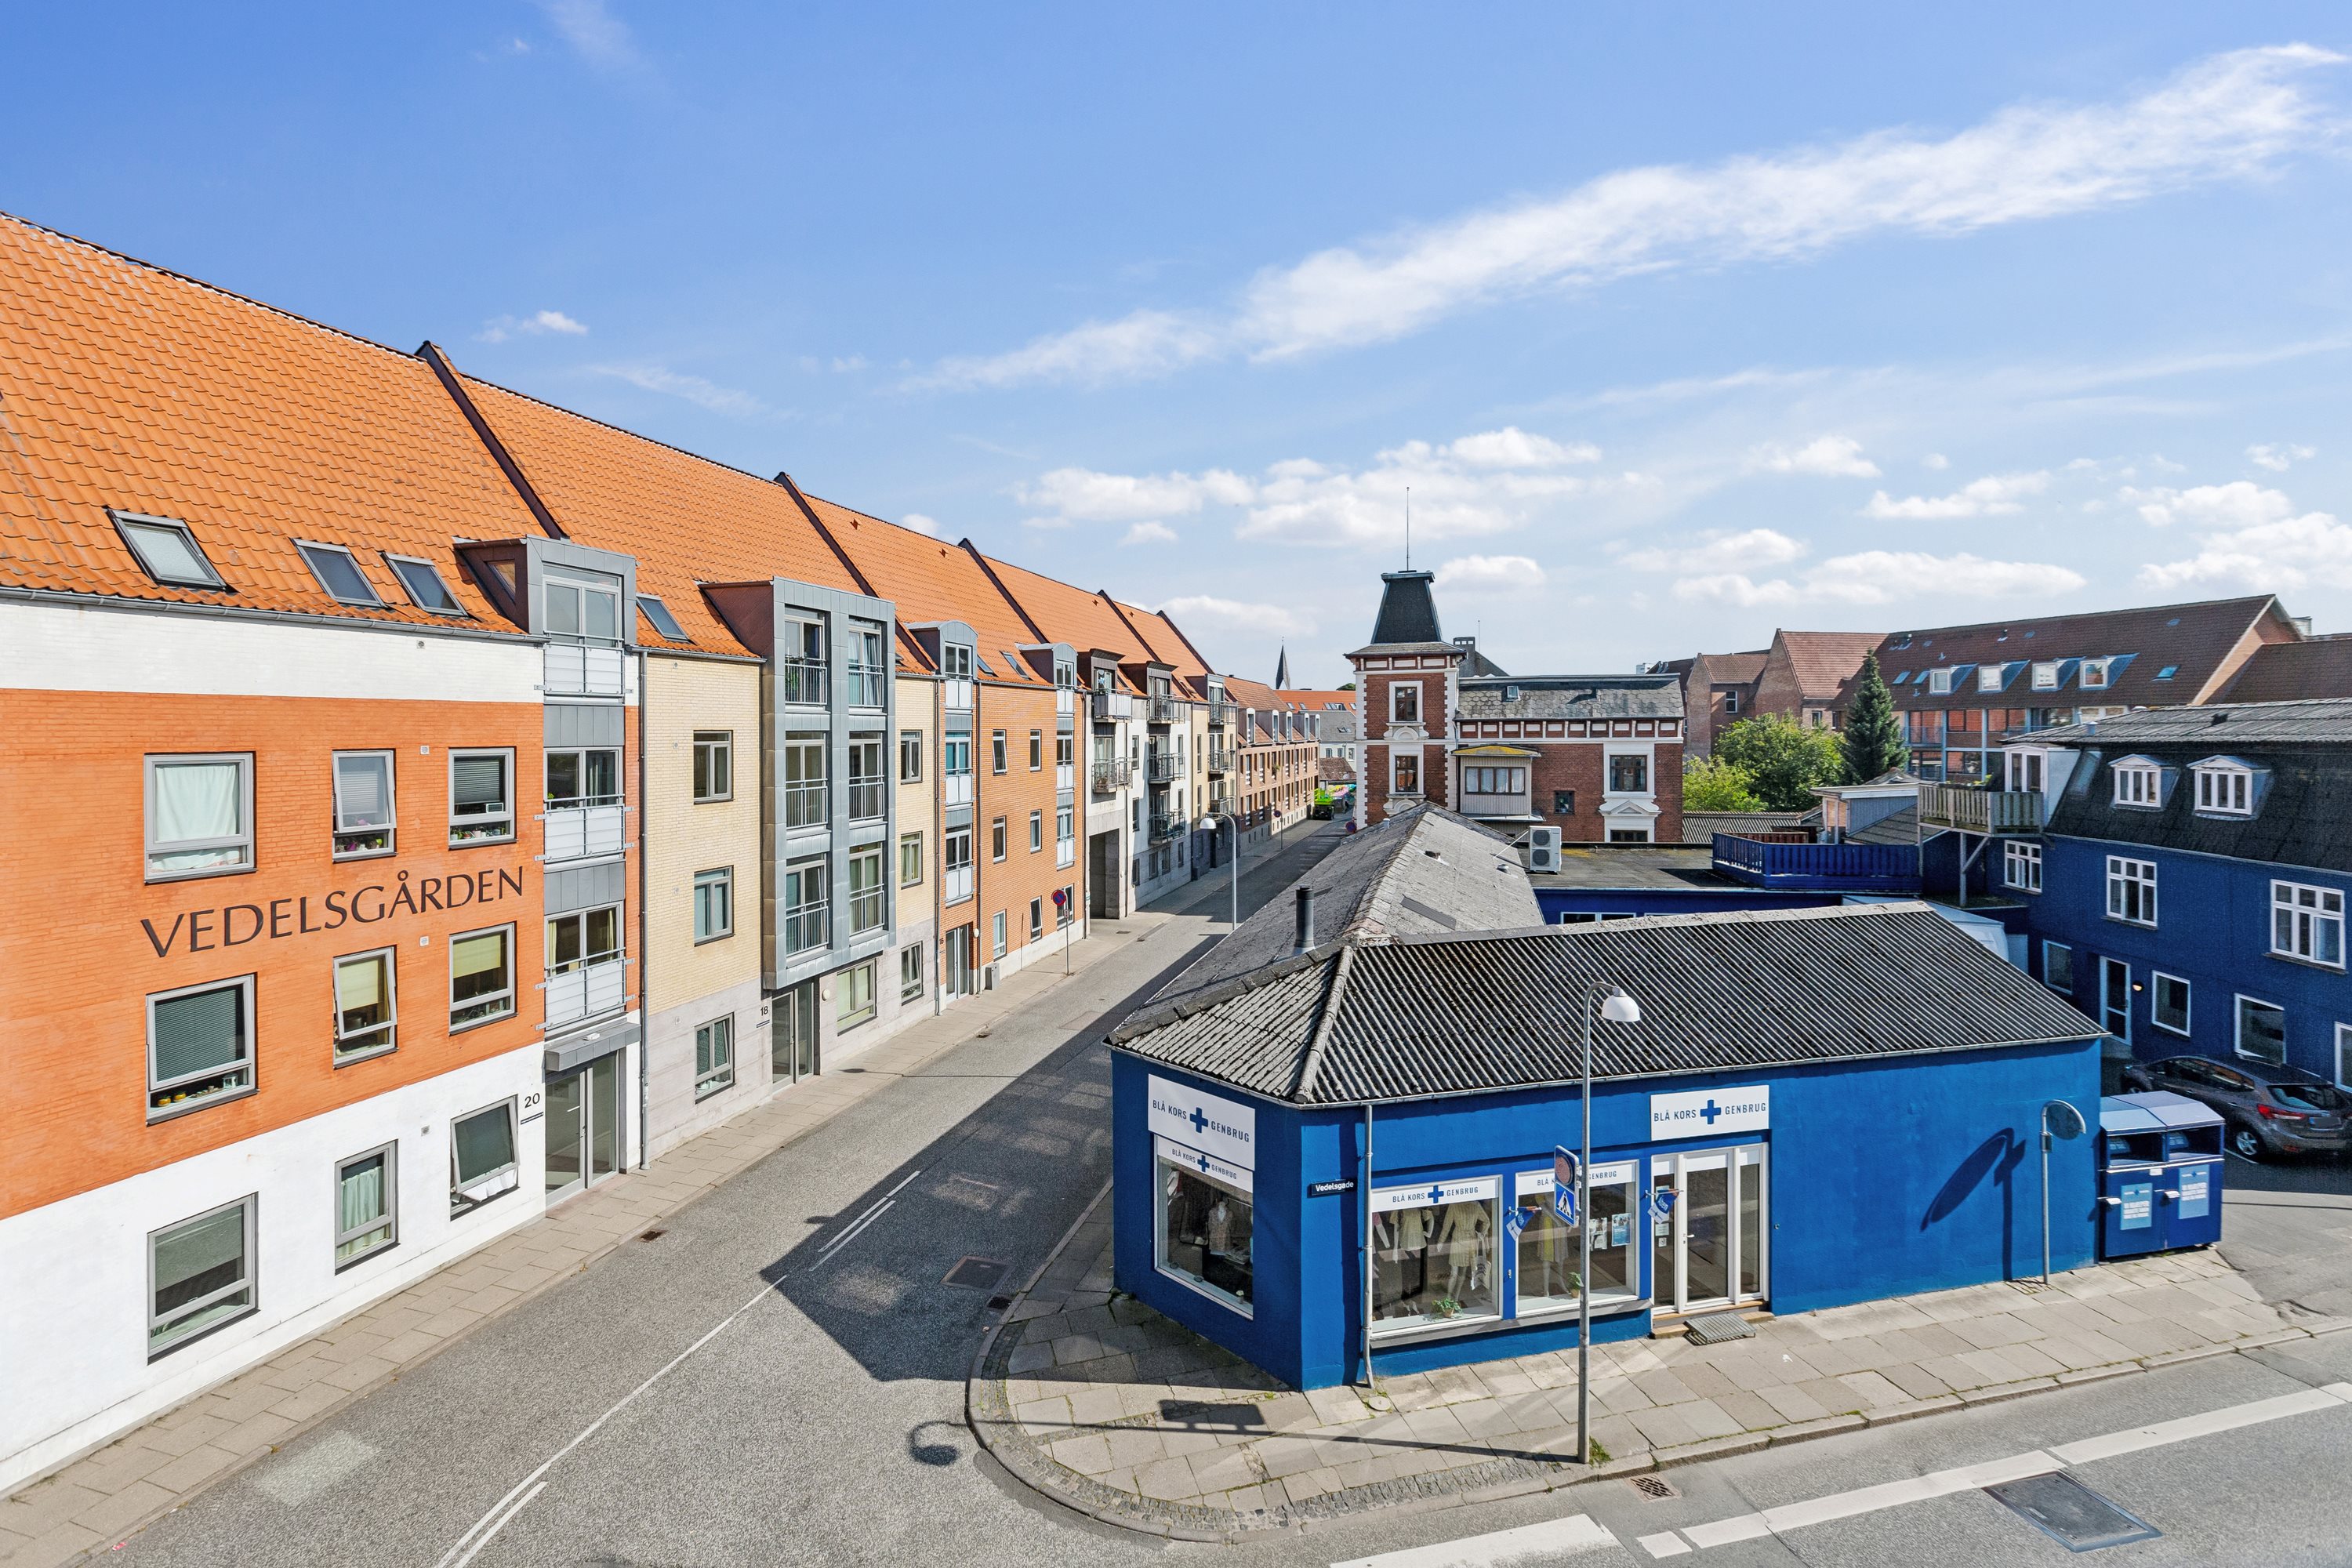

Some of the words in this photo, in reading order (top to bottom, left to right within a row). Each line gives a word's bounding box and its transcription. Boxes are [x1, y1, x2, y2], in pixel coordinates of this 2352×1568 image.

[140, 866, 523, 958] VEDELSGÅRDEN
[760, 1006, 768, 1016] 18
[524, 1092, 540, 1109] 20
[1653, 1110, 1671, 1122] BLÅ
[1674, 1109, 1697, 1120] KORS
[1725, 1102, 1766, 1115] GENBRUG
[1152, 1100, 1166, 1112] BLÅ
[1168, 1105, 1187, 1120] KORS
[1210, 1120, 1250, 1142] GENBRUG
[1172, 1149, 1181, 1157] BLÅ
[1182, 1152, 1196, 1163] KORS
[1211, 1164, 1237, 1179] GENBRUG
[1315, 1181, 1354, 1192] Vedelsgade
[1537, 1176, 1548, 1186] BLÅ
[1392, 1194, 1405, 1203] BLÅ
[1446, 1186, 1479, 1196] GENBRUG
